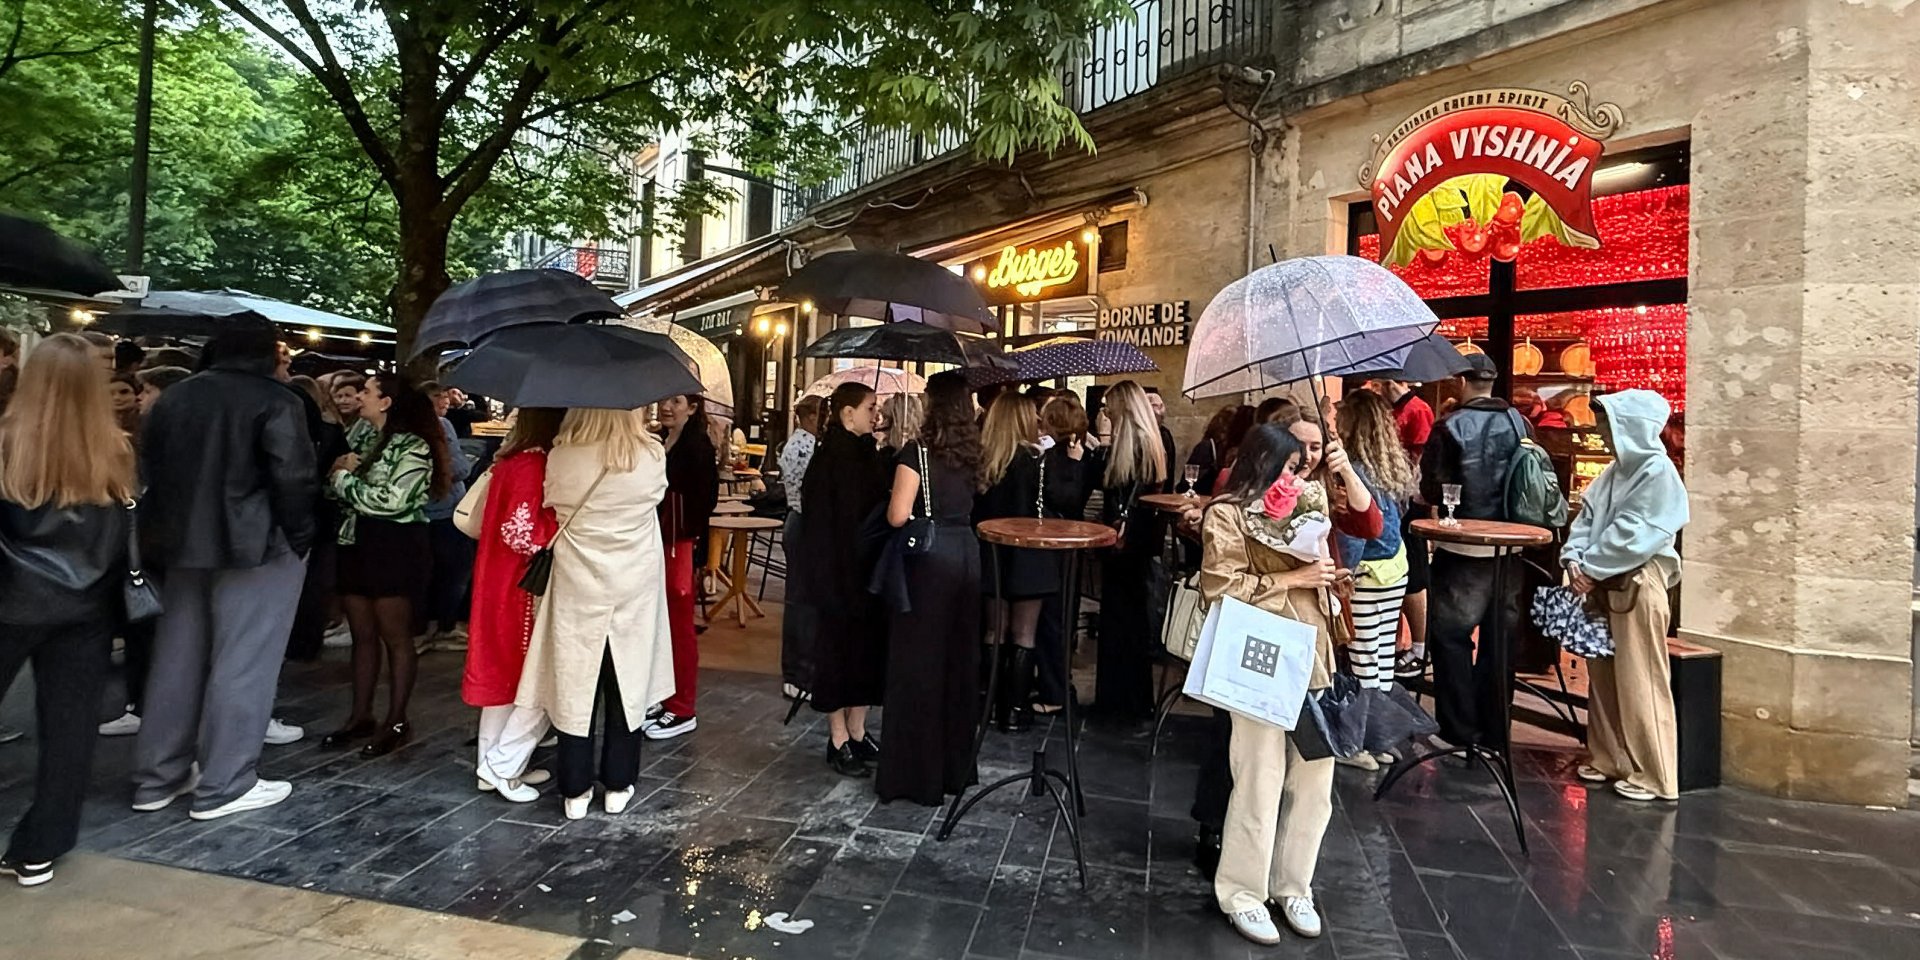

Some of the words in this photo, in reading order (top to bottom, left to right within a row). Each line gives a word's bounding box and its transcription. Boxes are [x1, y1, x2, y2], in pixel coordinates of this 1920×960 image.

[988, 240, 1079, 297] Burger
[1100, 305, 1156, 329] BORNE
[1161, 301, 1185, 324] DE
